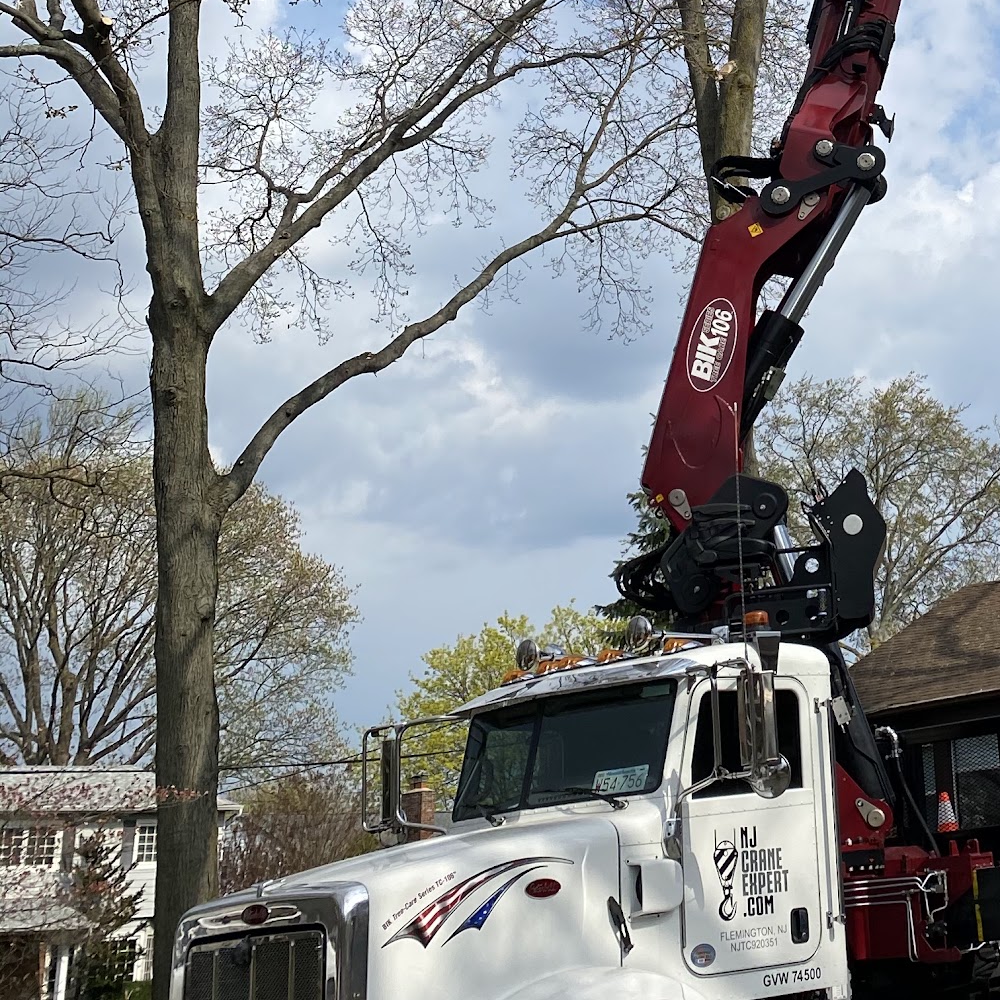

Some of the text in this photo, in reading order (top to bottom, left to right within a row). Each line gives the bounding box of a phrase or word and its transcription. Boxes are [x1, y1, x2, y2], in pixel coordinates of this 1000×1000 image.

[710, 308, 733, 337] 106
[691, 331, 720, 381] BIK
[740, 826, 757, 848] NJ
[741, 848, 782, 872] CRANE
[418, 884, 435, 899] Series
[742, 870, 789, 896] EXPERT
[743, 895, 774, 917] .COM
[720, 925, 788, 941] FLEMINGTON, NJ
[731, 938, 778, 952] NJTC920351
[763, 967, 822, 987] GVW 74500
